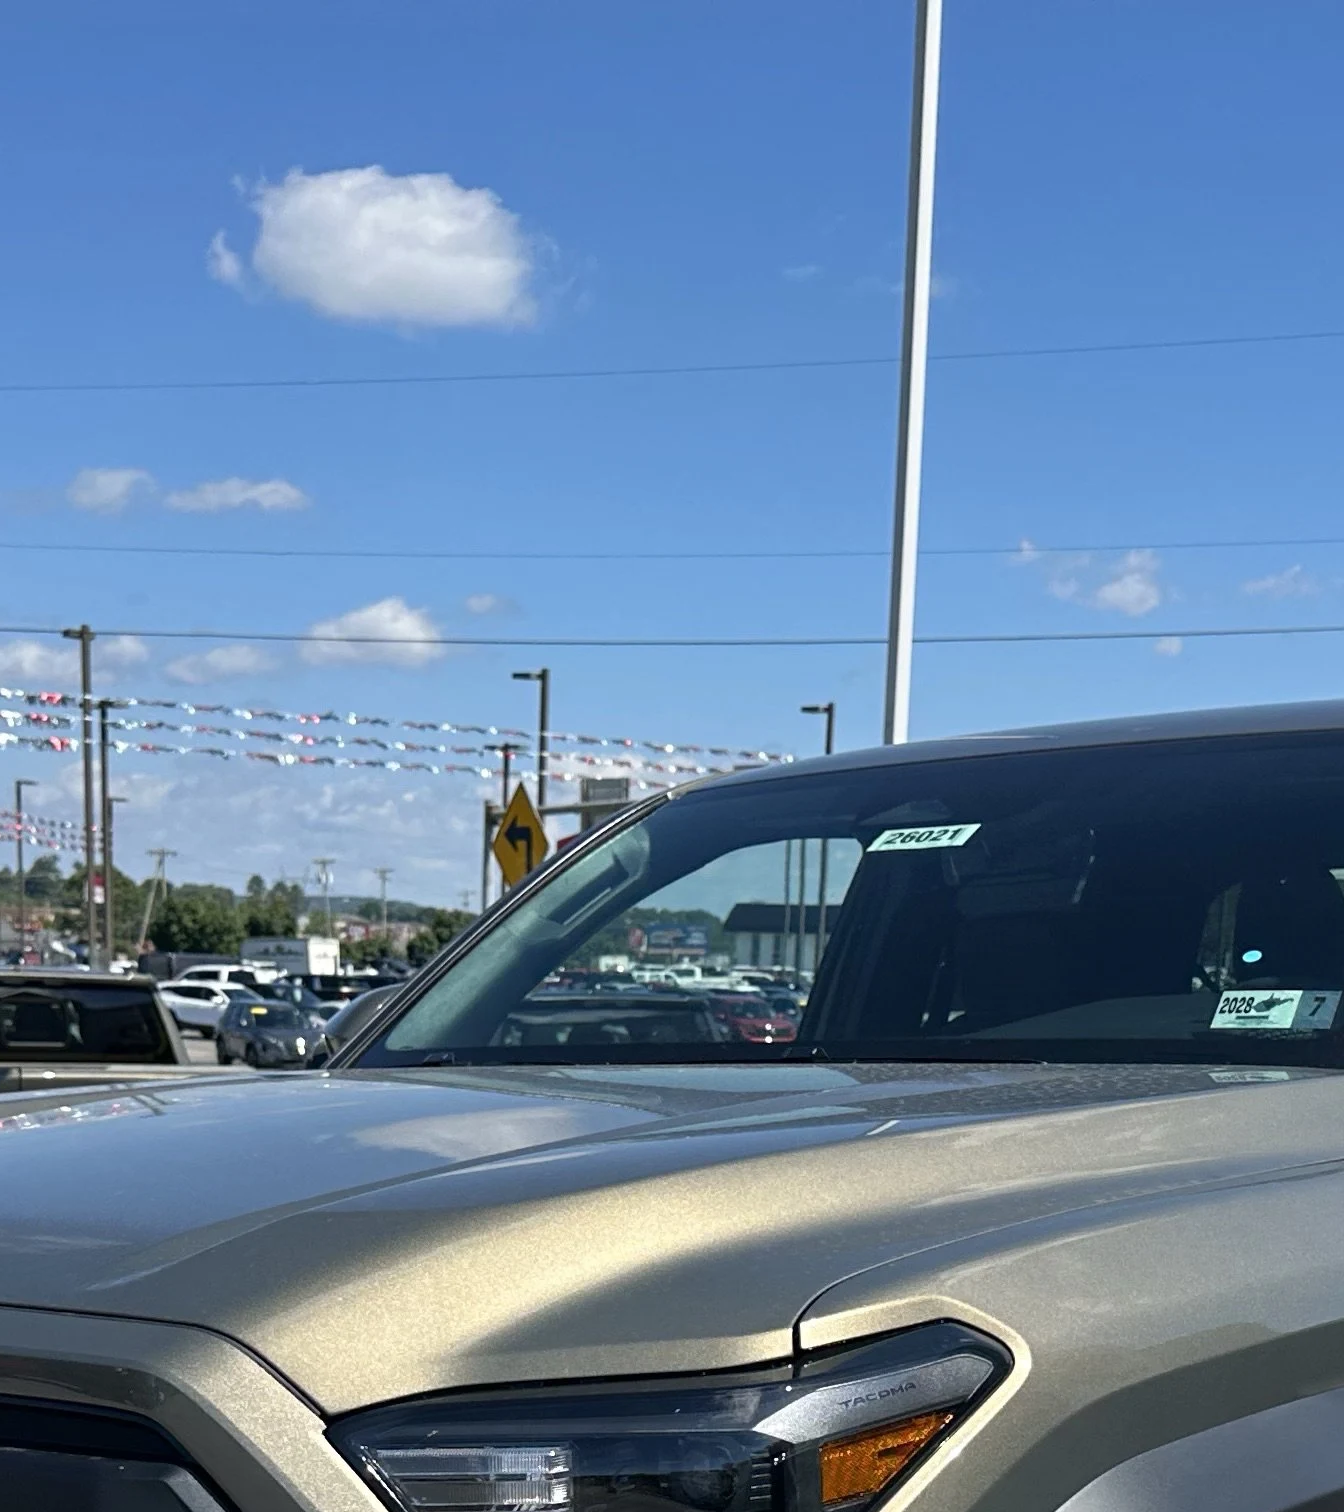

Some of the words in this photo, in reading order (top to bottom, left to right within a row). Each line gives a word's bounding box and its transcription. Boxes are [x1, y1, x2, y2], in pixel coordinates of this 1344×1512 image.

[882, 827, 966, 844] 26021
[1219, 996, 1255, 1014] 2028
[1309, 996, 1327, 1017] 7
[837, 1382, 916, 1409] TACOMA
